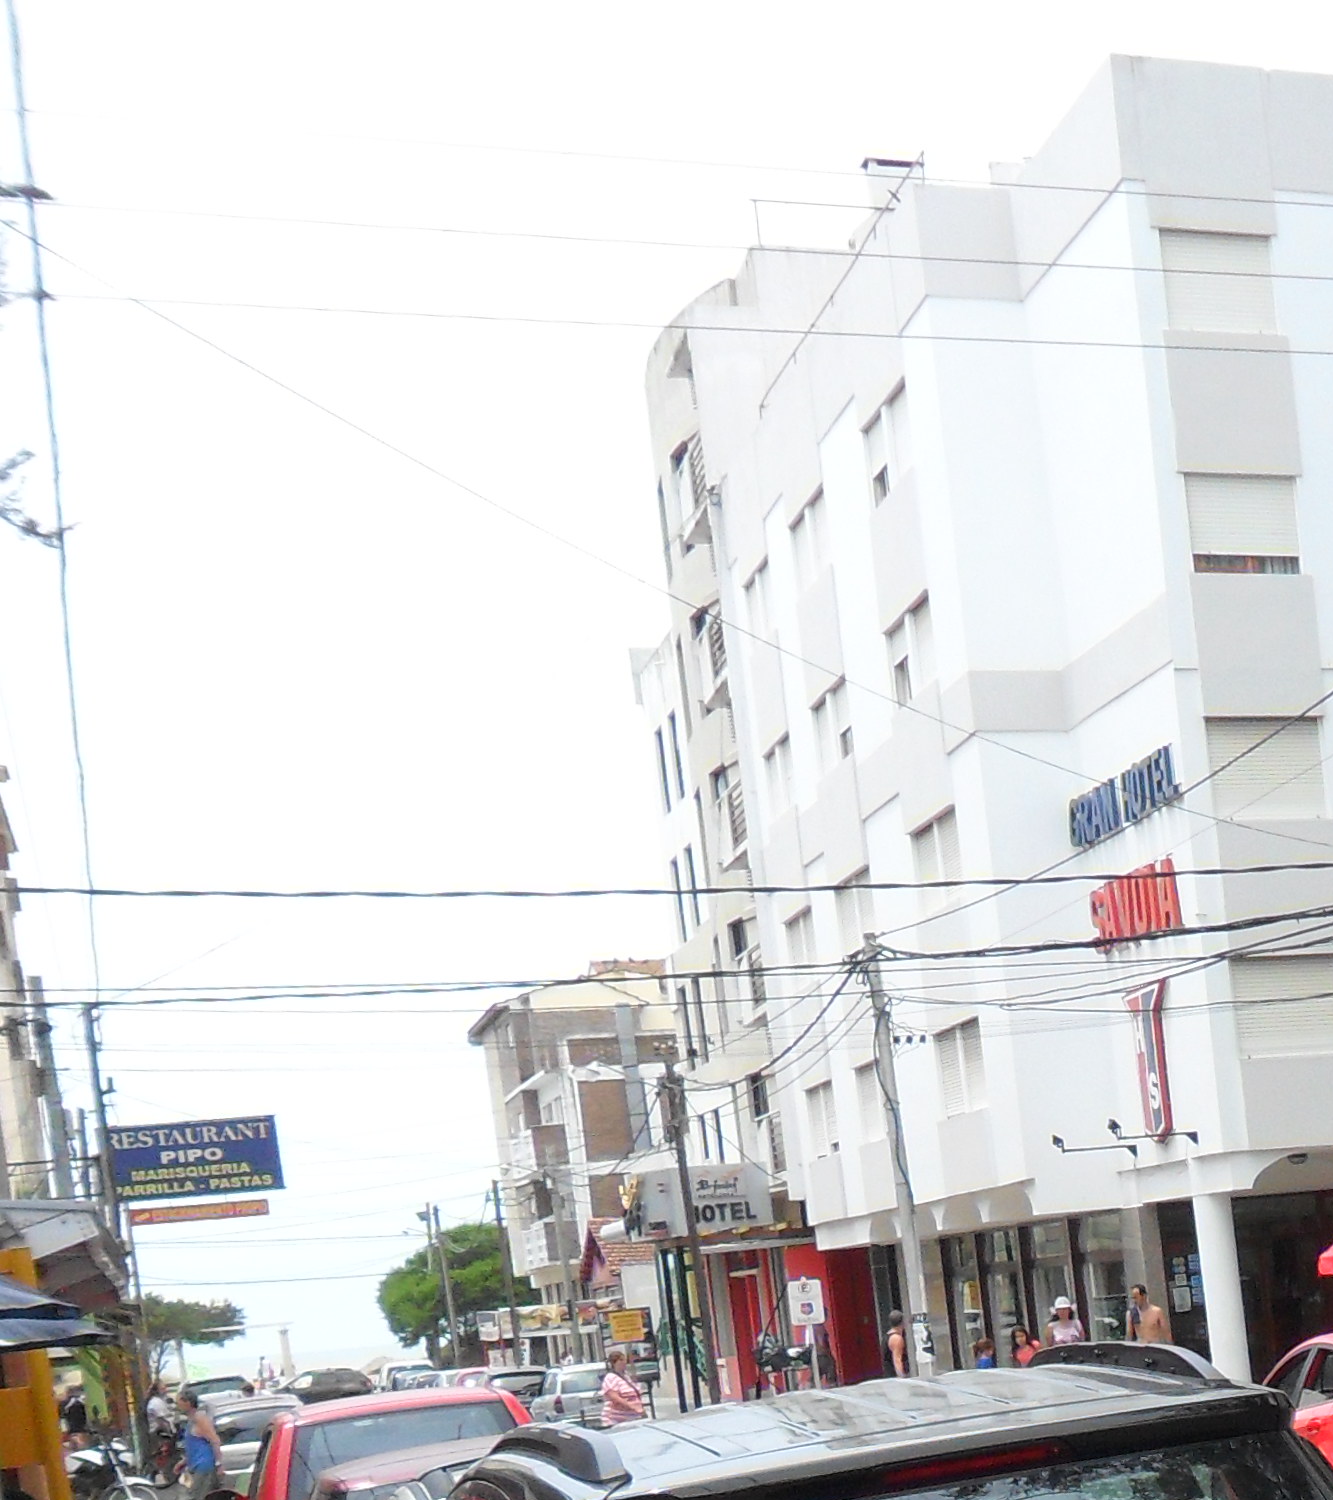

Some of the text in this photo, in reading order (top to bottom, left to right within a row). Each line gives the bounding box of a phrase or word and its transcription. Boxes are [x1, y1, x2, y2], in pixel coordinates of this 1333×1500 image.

[1119, 743, 1183, 823] HOTEL
[1089, 856, 1184, 954] SAVOIA
[110, 1121, 269, 1150] RESTAURANT
[160, 1147, 223, 1165] PIPO
[131, 1161, 251, 1182] MARISQUERIA
[209, 1174, 273, 1190] PASTAS
